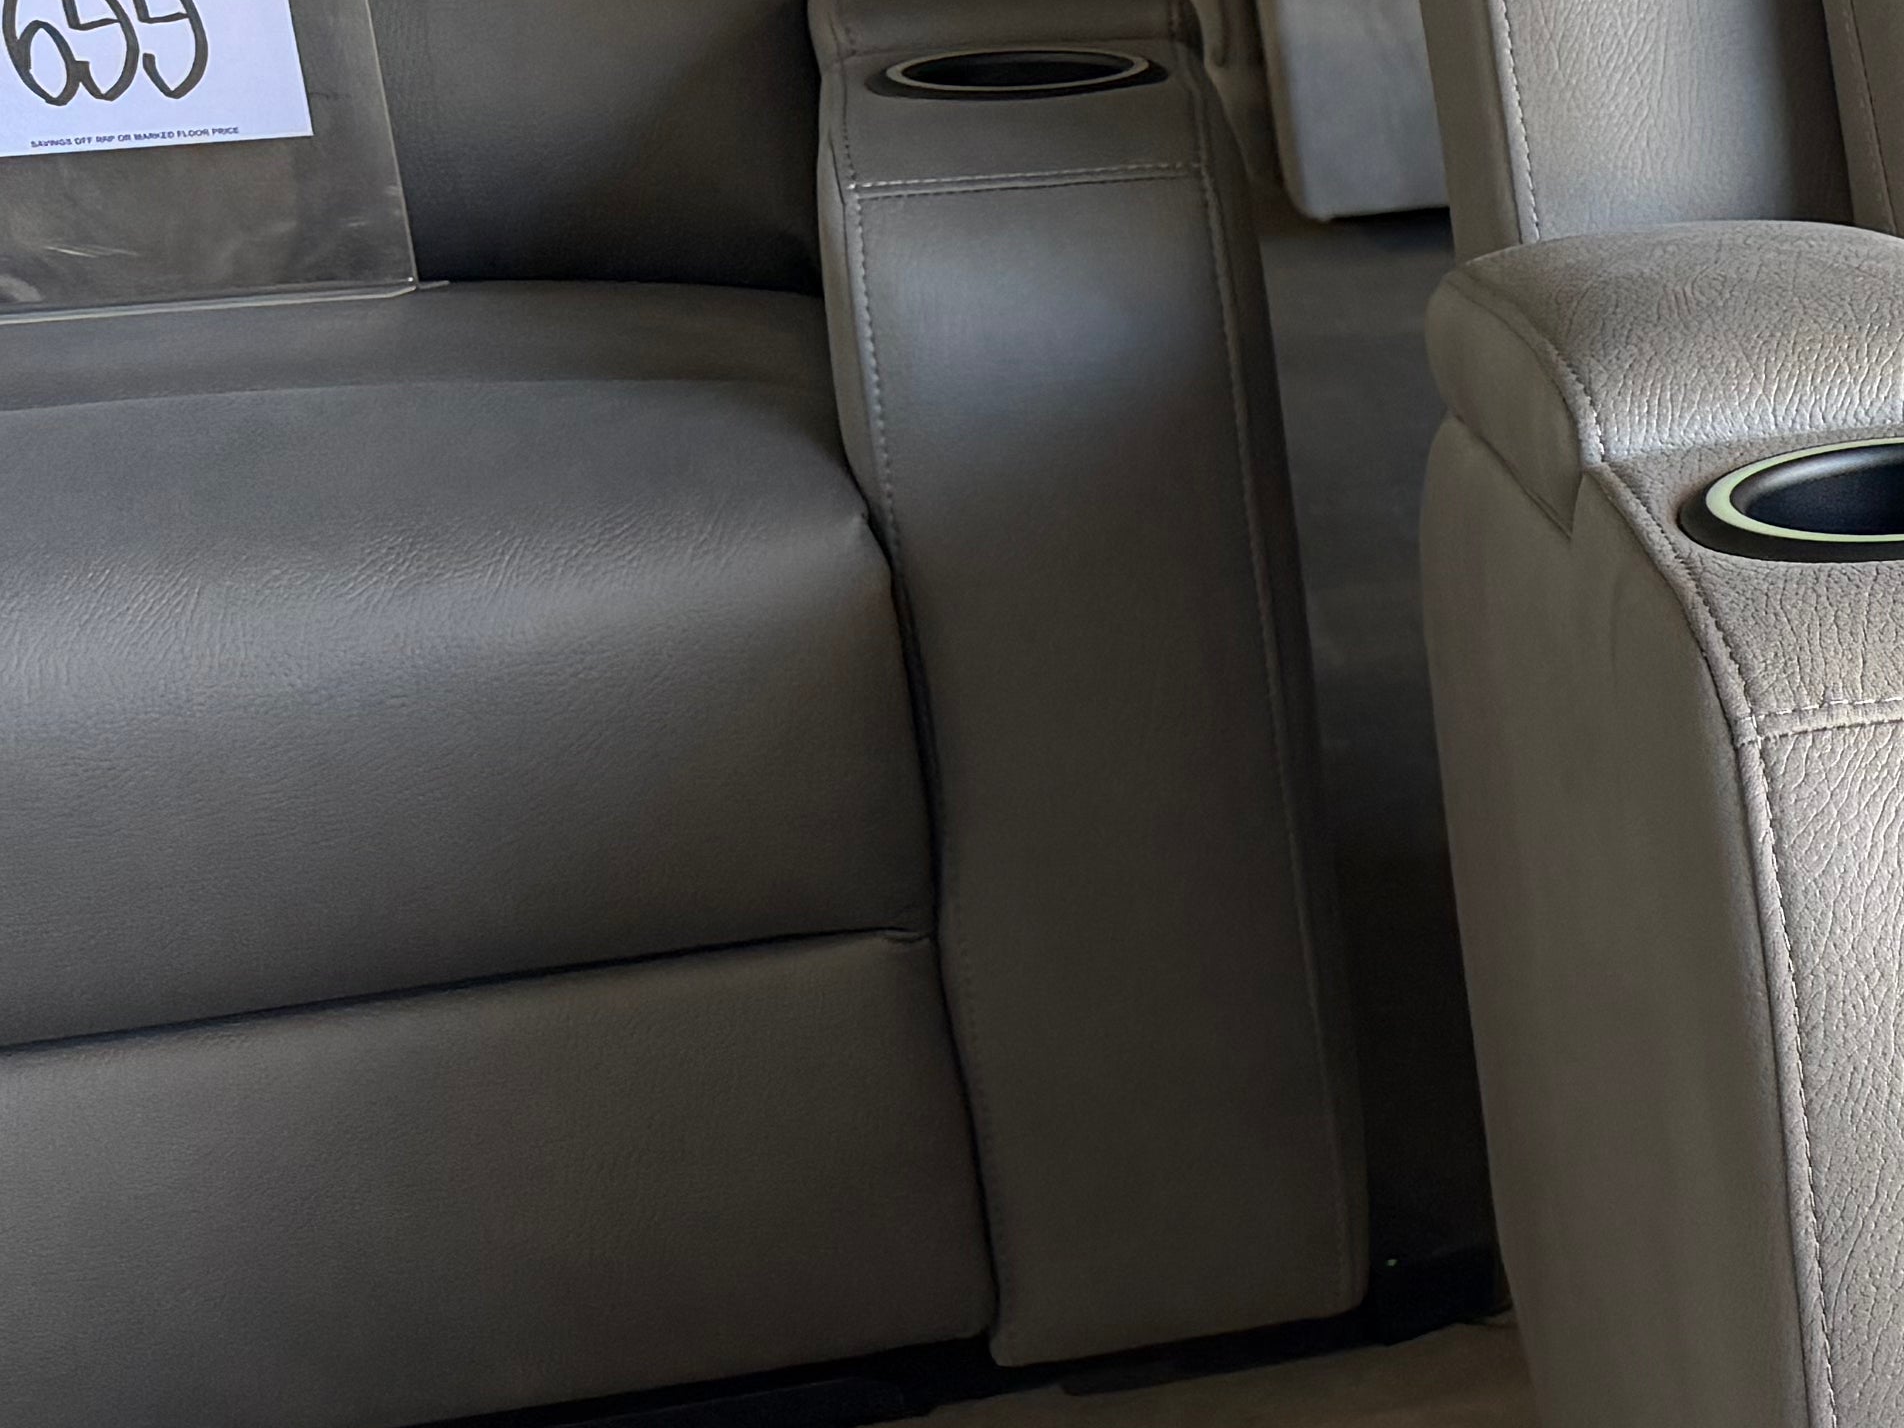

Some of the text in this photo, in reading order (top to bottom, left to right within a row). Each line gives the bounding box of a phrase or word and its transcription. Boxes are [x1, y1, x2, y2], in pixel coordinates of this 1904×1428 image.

[31, 138, 73, 148] SAVINGS
[74, 136, 92, 145] OFF
[133, 131, 175, 141] MARKED
[176, 128, 210, 138] FLOOR
[211, 126, 239, 135] PRICE
